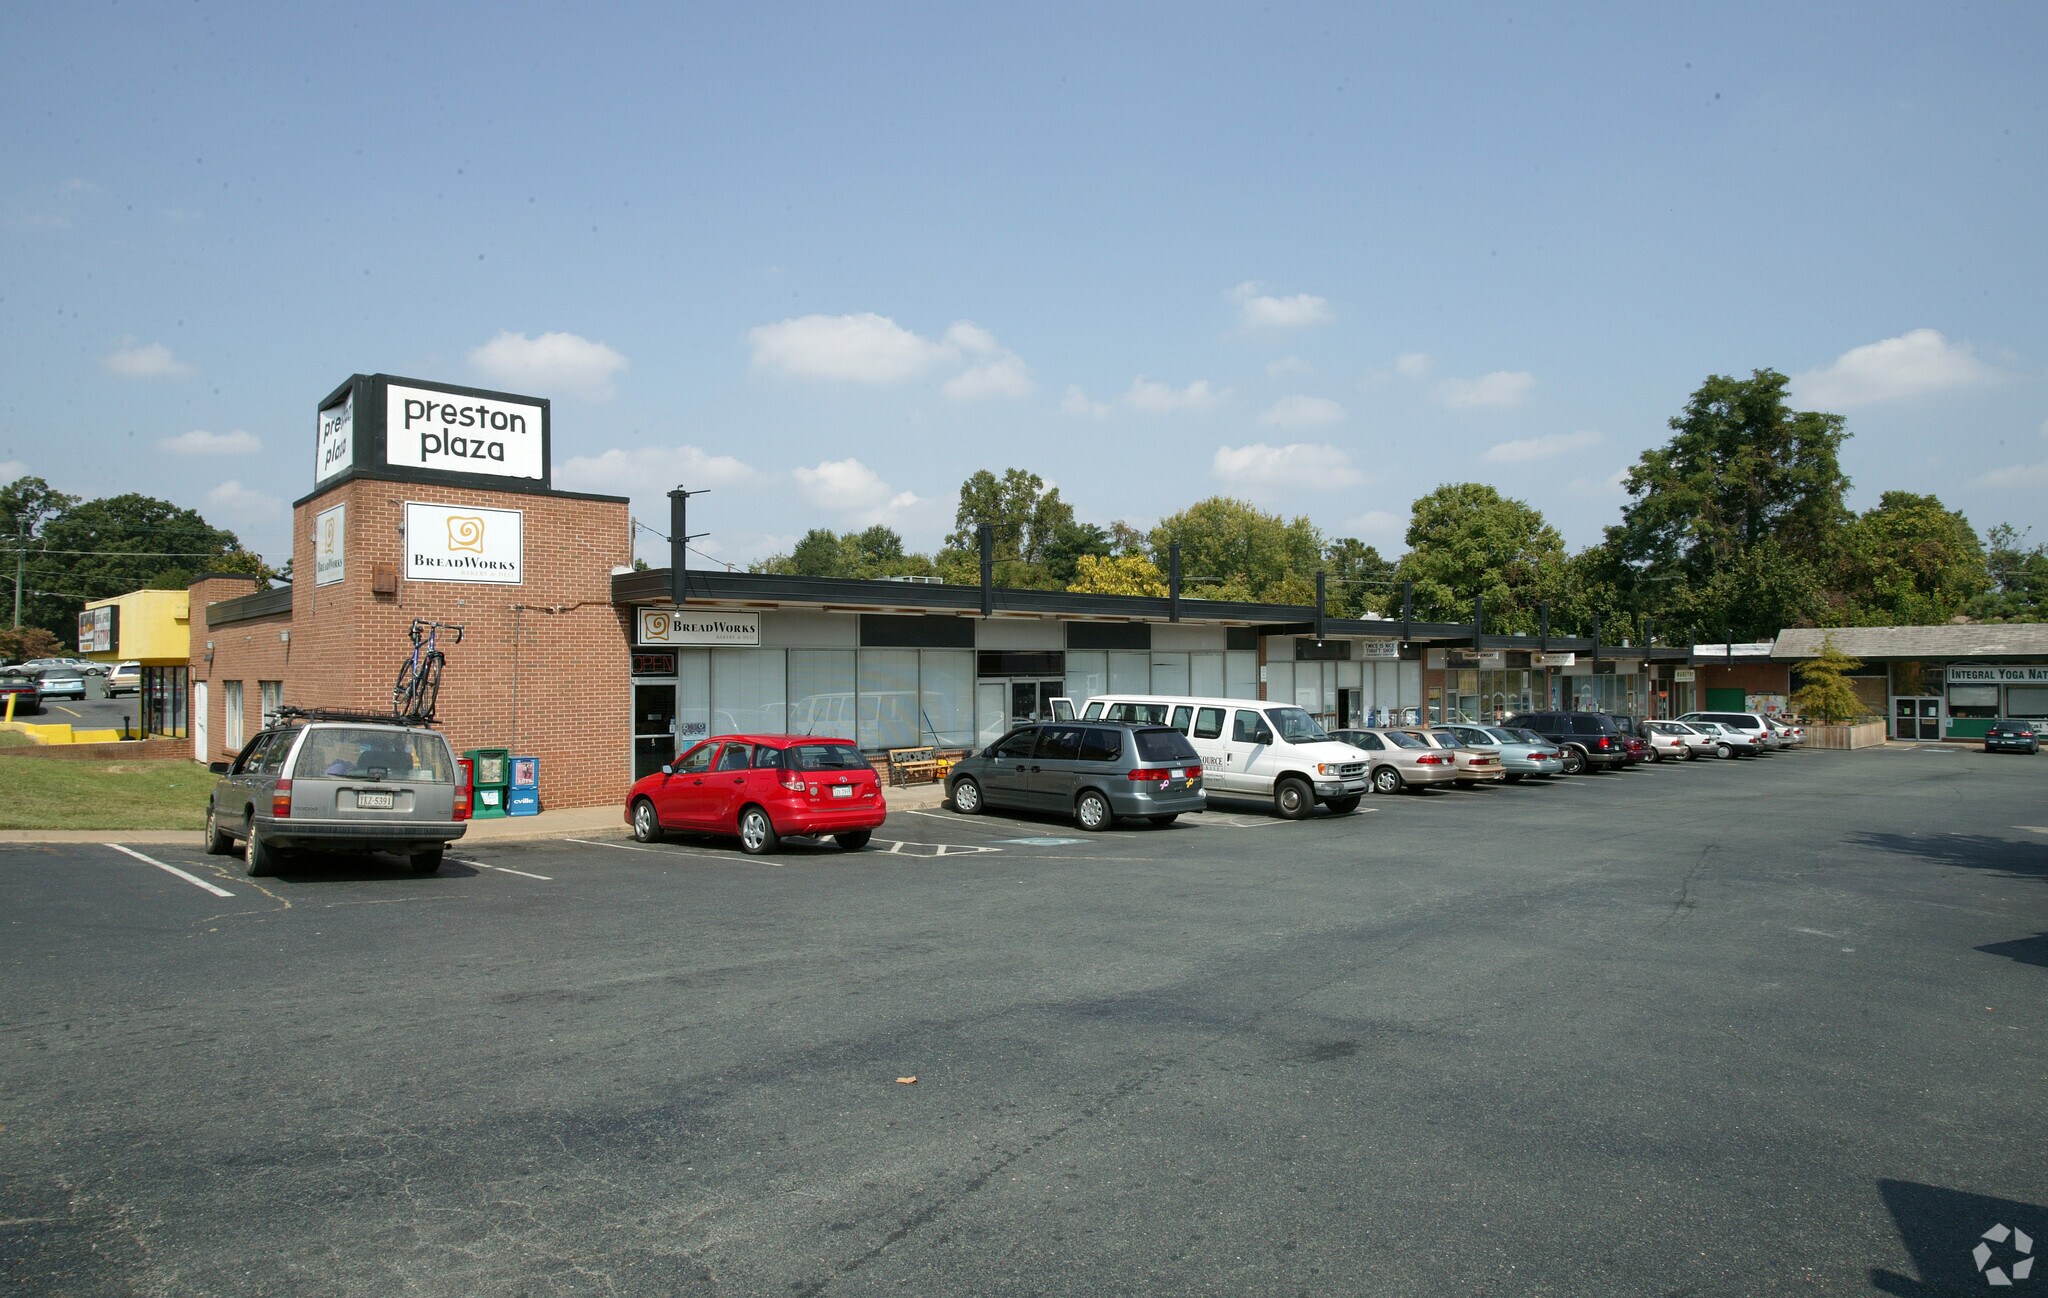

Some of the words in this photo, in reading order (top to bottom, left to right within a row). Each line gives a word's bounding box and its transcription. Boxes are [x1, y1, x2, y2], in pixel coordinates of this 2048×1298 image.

[404, 398, 527, 434] preston
[421, 428, 505, 462] plaza
[633, 655, 673, 673] OPEN
[1951, 669, 1995, 679] INTEGRAL
[1999, 669, 2024, 679] YOGA
